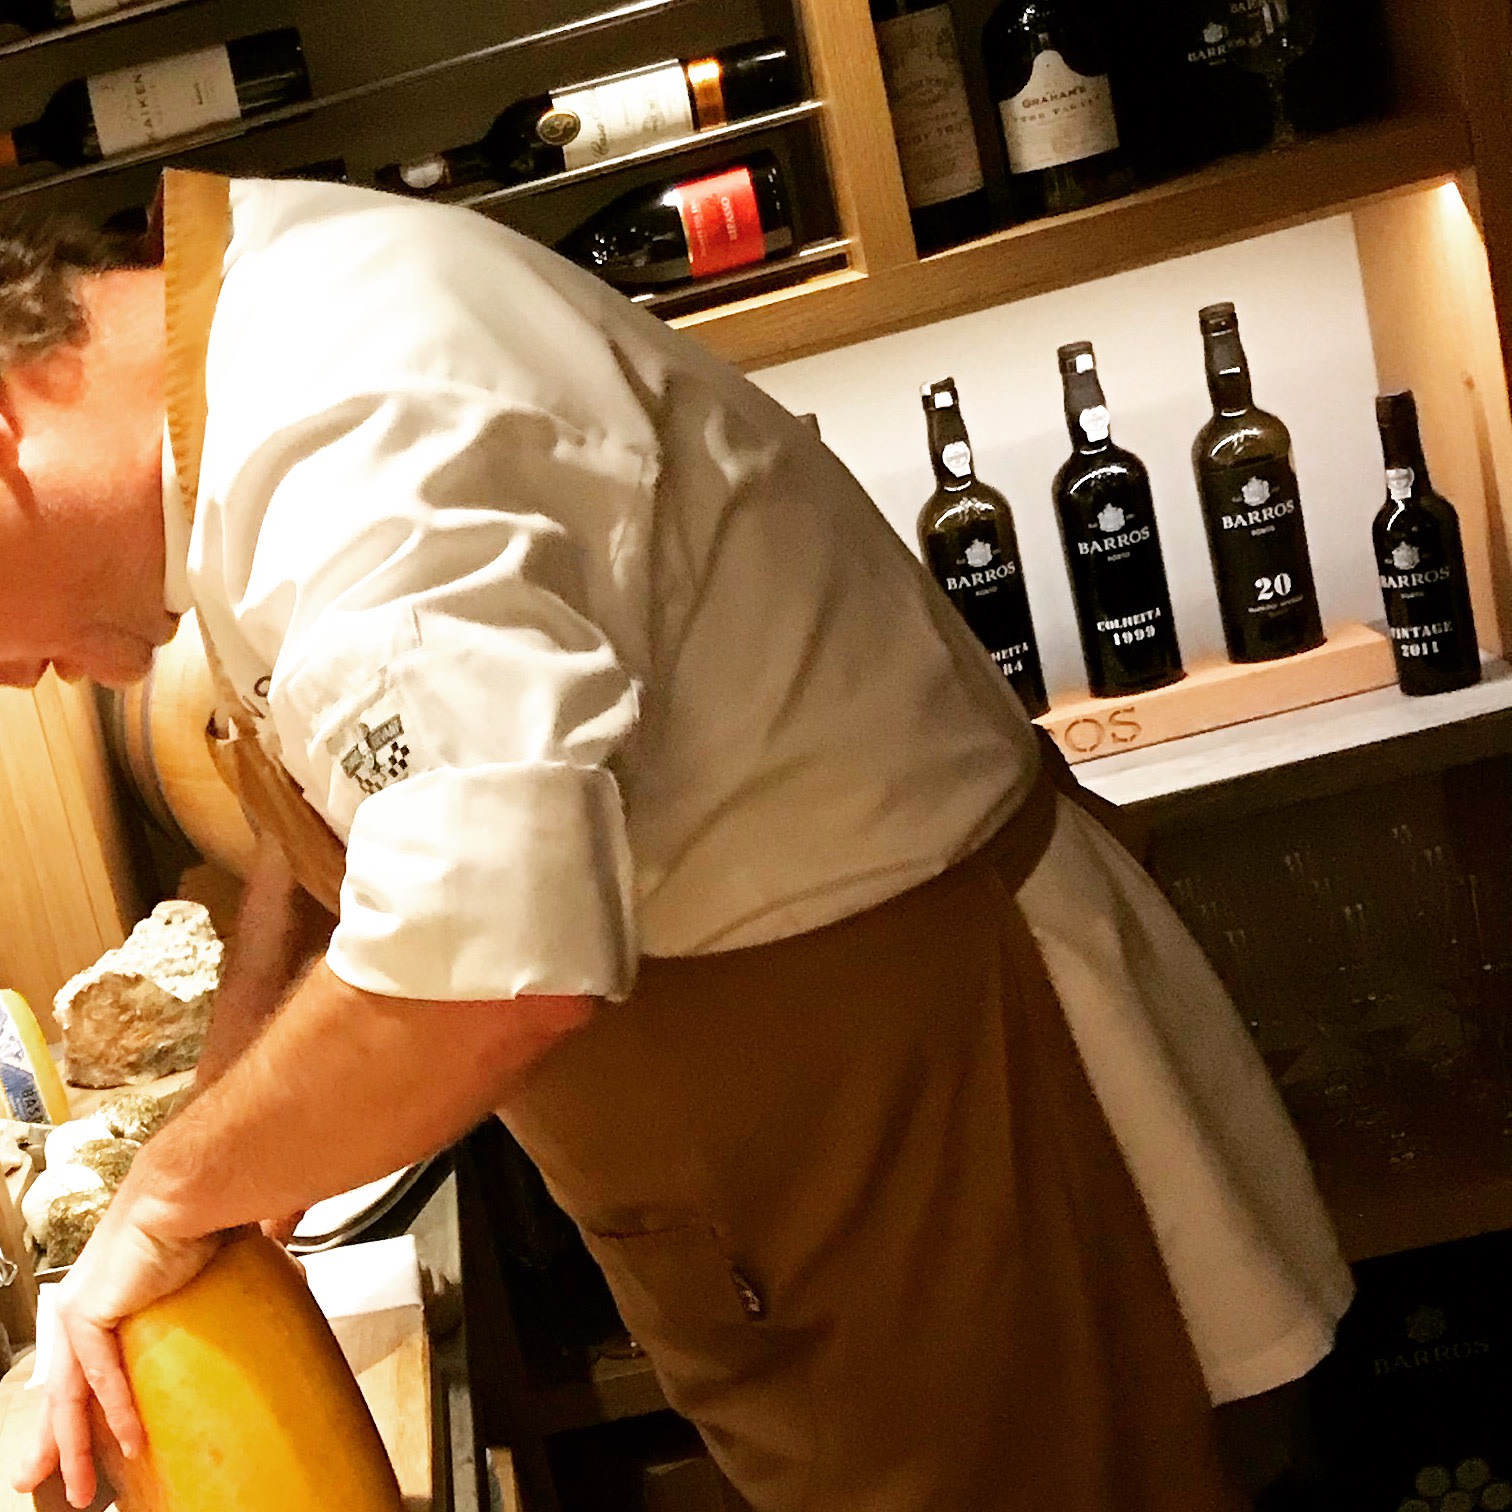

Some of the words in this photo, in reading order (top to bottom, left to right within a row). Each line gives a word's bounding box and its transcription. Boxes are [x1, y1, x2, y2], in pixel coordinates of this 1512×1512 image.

[1221, 499, 1295, 530] BARROS
[1078, 526, 1150, 555] BARROS
[946, 561, 1016, 591] BARROS
[1254, 572, 1292, 601] 20
[1096, 607, 1161, 632] COLHEITA
[1113, 624, 1156, 646] 1999
[1400, 640, 1440, 659] 2011
[1062, 705, 1142, 754] OS
